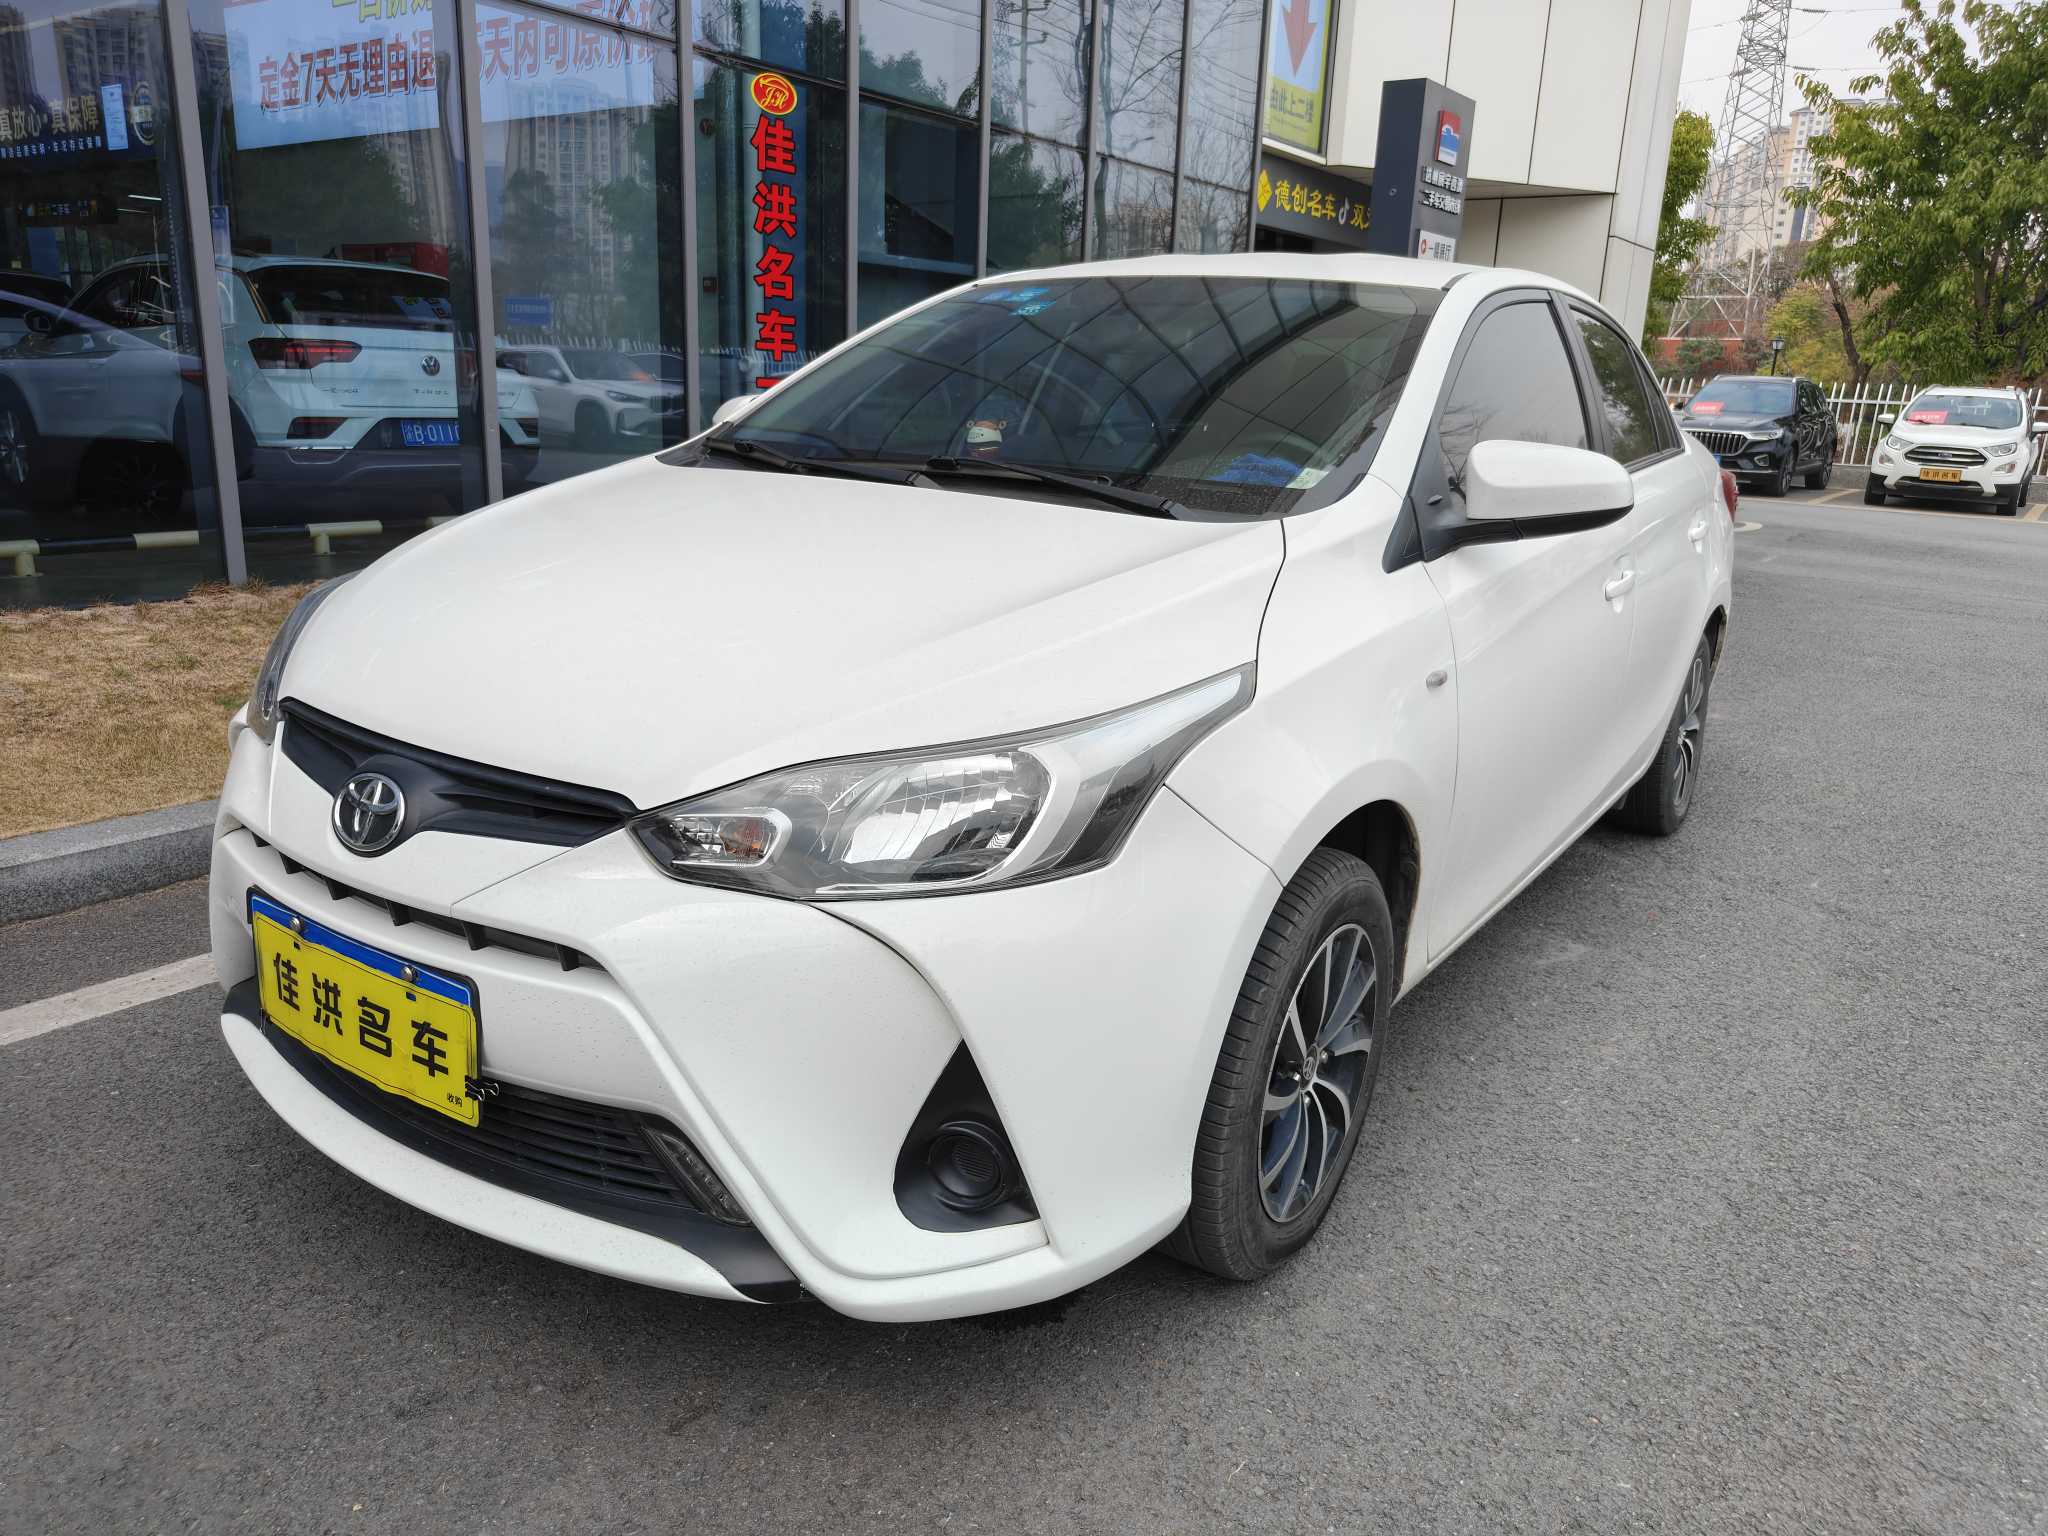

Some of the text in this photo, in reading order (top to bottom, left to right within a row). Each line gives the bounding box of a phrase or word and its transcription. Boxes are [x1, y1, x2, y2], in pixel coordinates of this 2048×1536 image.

[259, 29, 435, 112] 定金7天无理由退
[1275, 180, 1337, 220] 德创名车
[273, 951, 449, 1078] 佳洪名车
